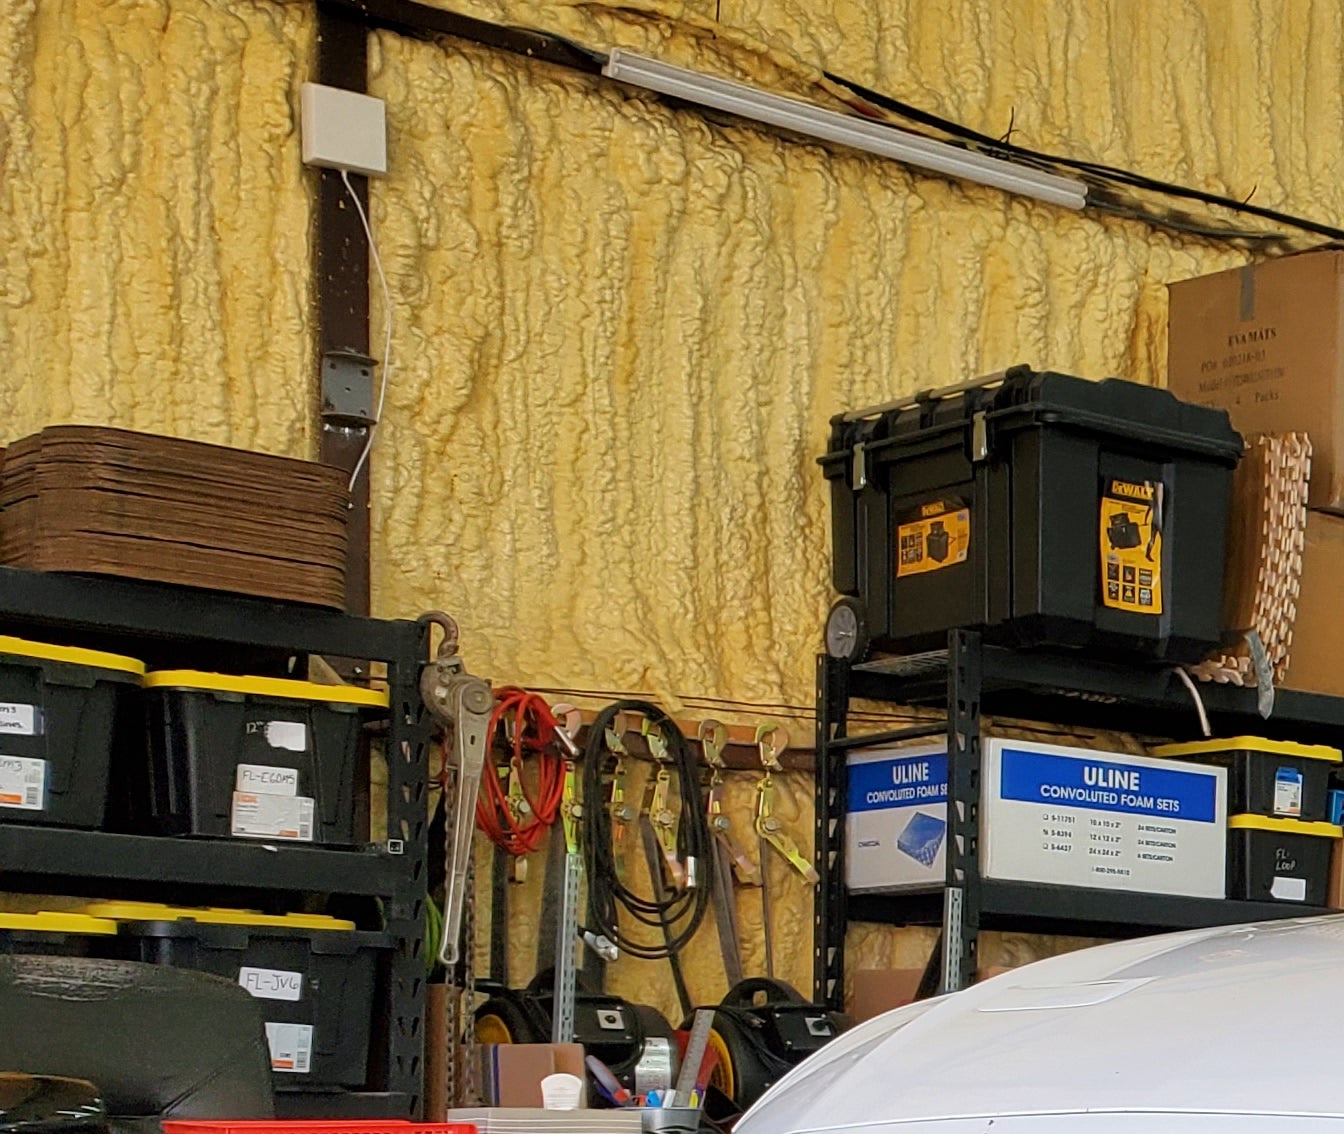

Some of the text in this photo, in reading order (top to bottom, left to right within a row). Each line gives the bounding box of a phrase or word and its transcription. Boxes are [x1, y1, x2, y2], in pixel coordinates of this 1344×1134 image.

[1248, 328, 1277, 342] MATS
[892, 762, 929, 785] ULINE
[1083, 766, 1140, 791] ULINE
[866, 787, 916, 804] CONVOLUTED
[917, 784, 939, 799] FOAM
[1040, 784, 1180, 812] CONVOLUTED FOAM SETS
